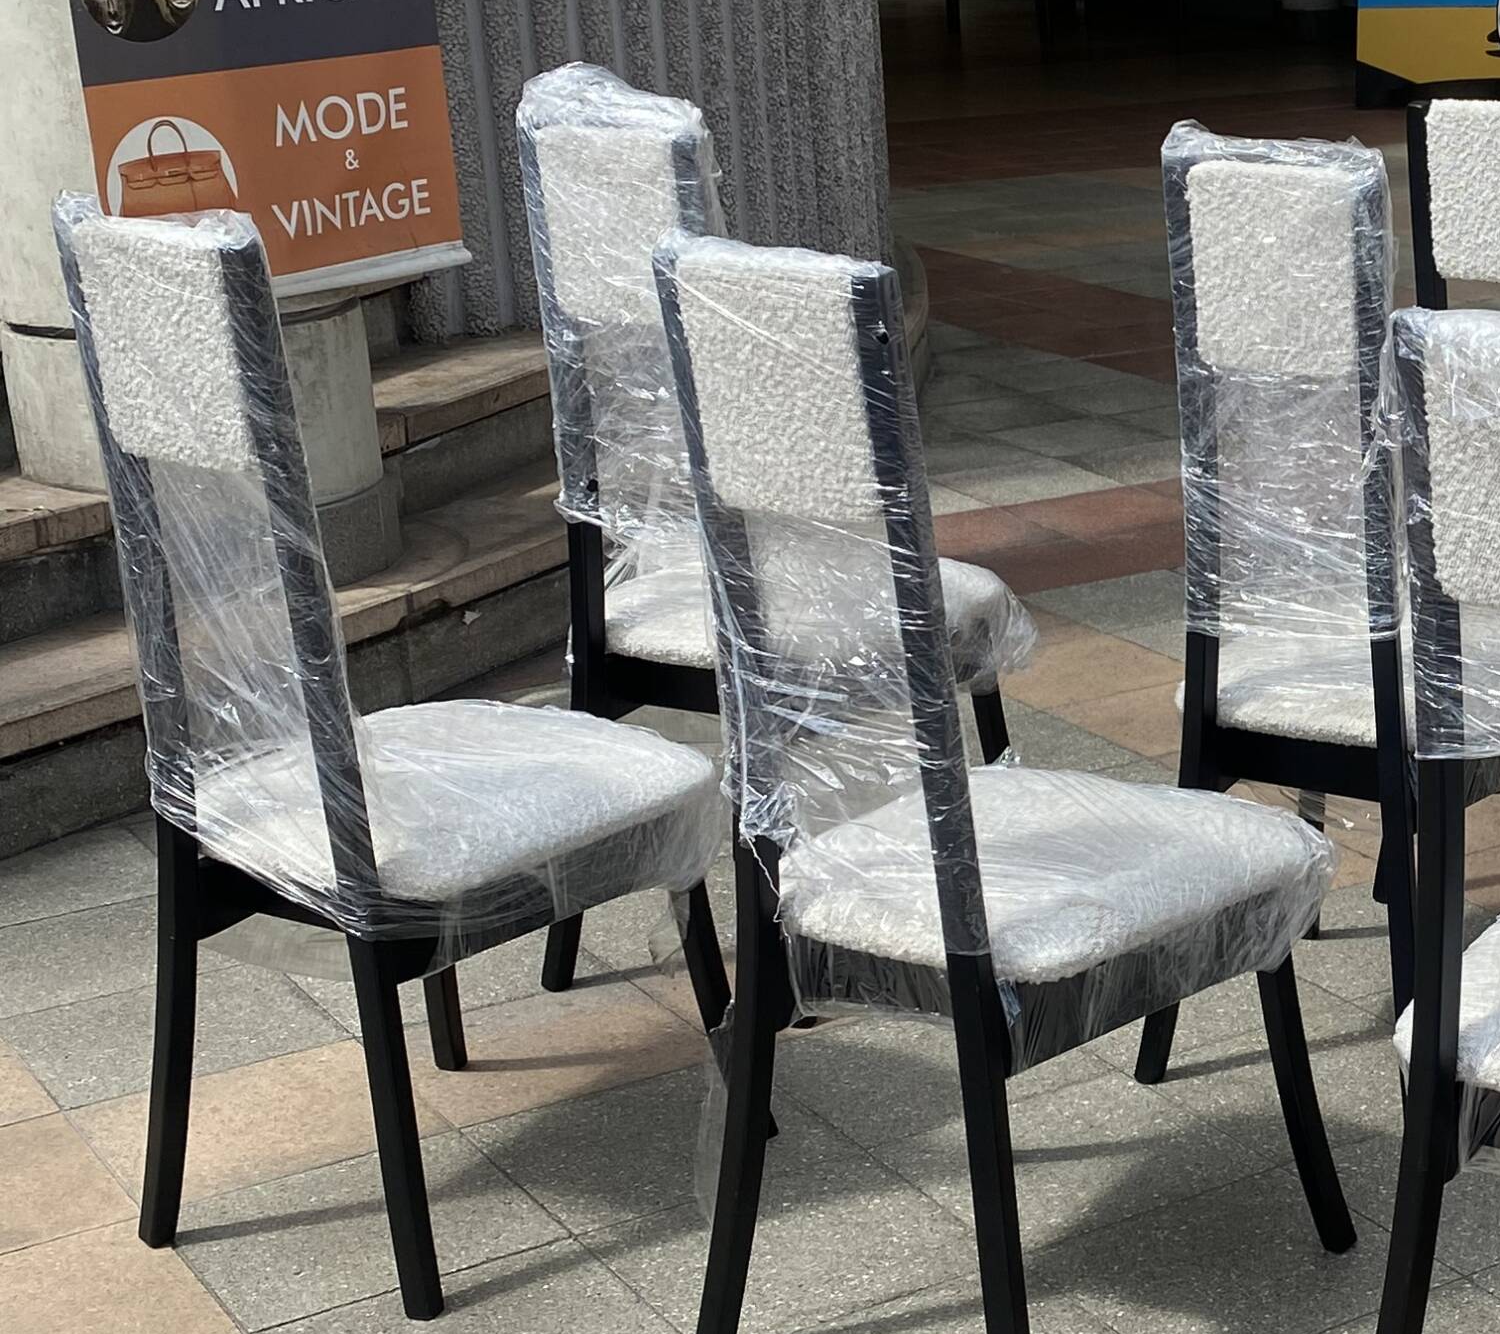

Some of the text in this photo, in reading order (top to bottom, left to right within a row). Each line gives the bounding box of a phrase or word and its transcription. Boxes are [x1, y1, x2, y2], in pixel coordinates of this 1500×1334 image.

[275, 87, 409, 148] MODE
[345, 149, 360, 170] &
[271, 178, 431, 240] VINTAGE
